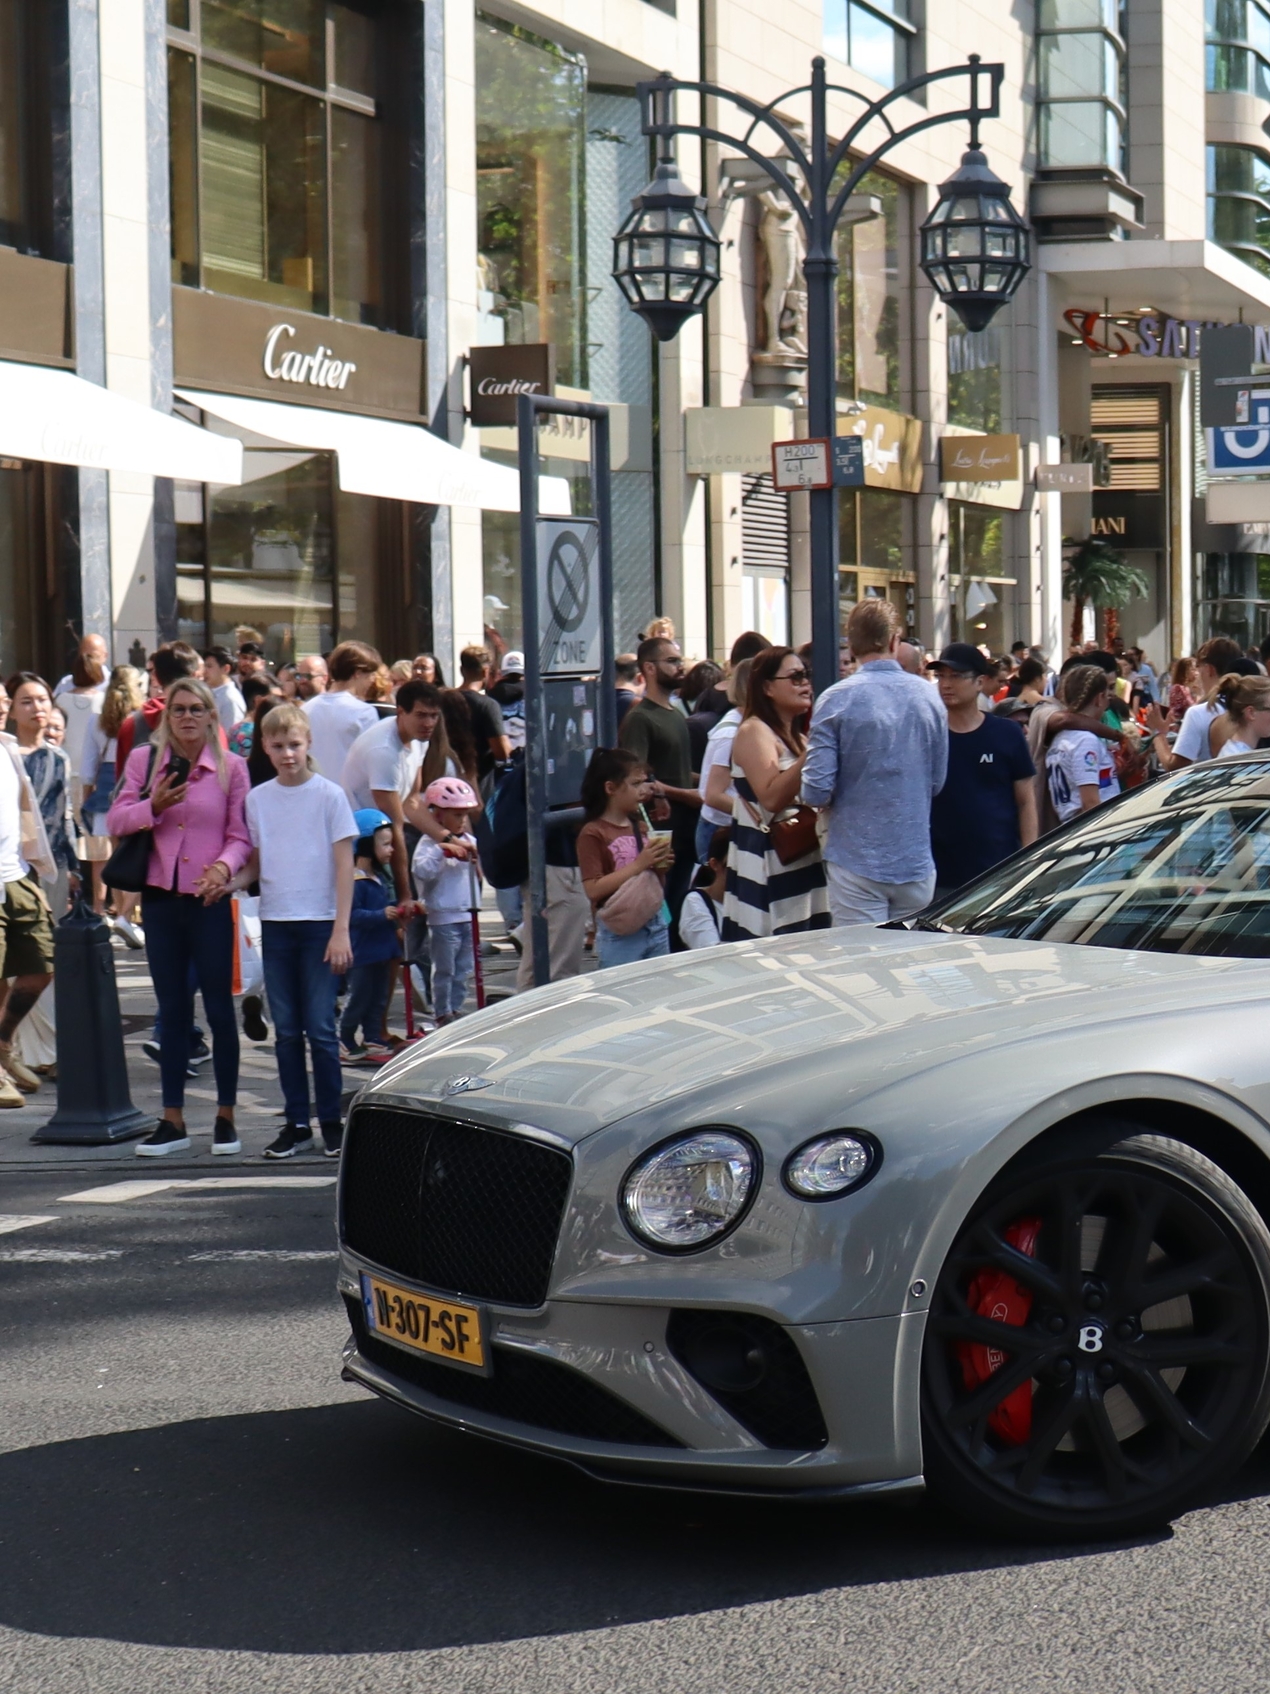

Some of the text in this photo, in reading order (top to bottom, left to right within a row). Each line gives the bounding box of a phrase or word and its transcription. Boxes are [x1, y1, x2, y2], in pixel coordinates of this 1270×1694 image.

[264, 324, 356, 389] Cartier
[478, 377, 541, 396] Cartier
[553, 641, 586, 664] ZONE
[375, 1287, 470, 1354] N-307-SF
[1078, 1326, 1103, 1353] B
